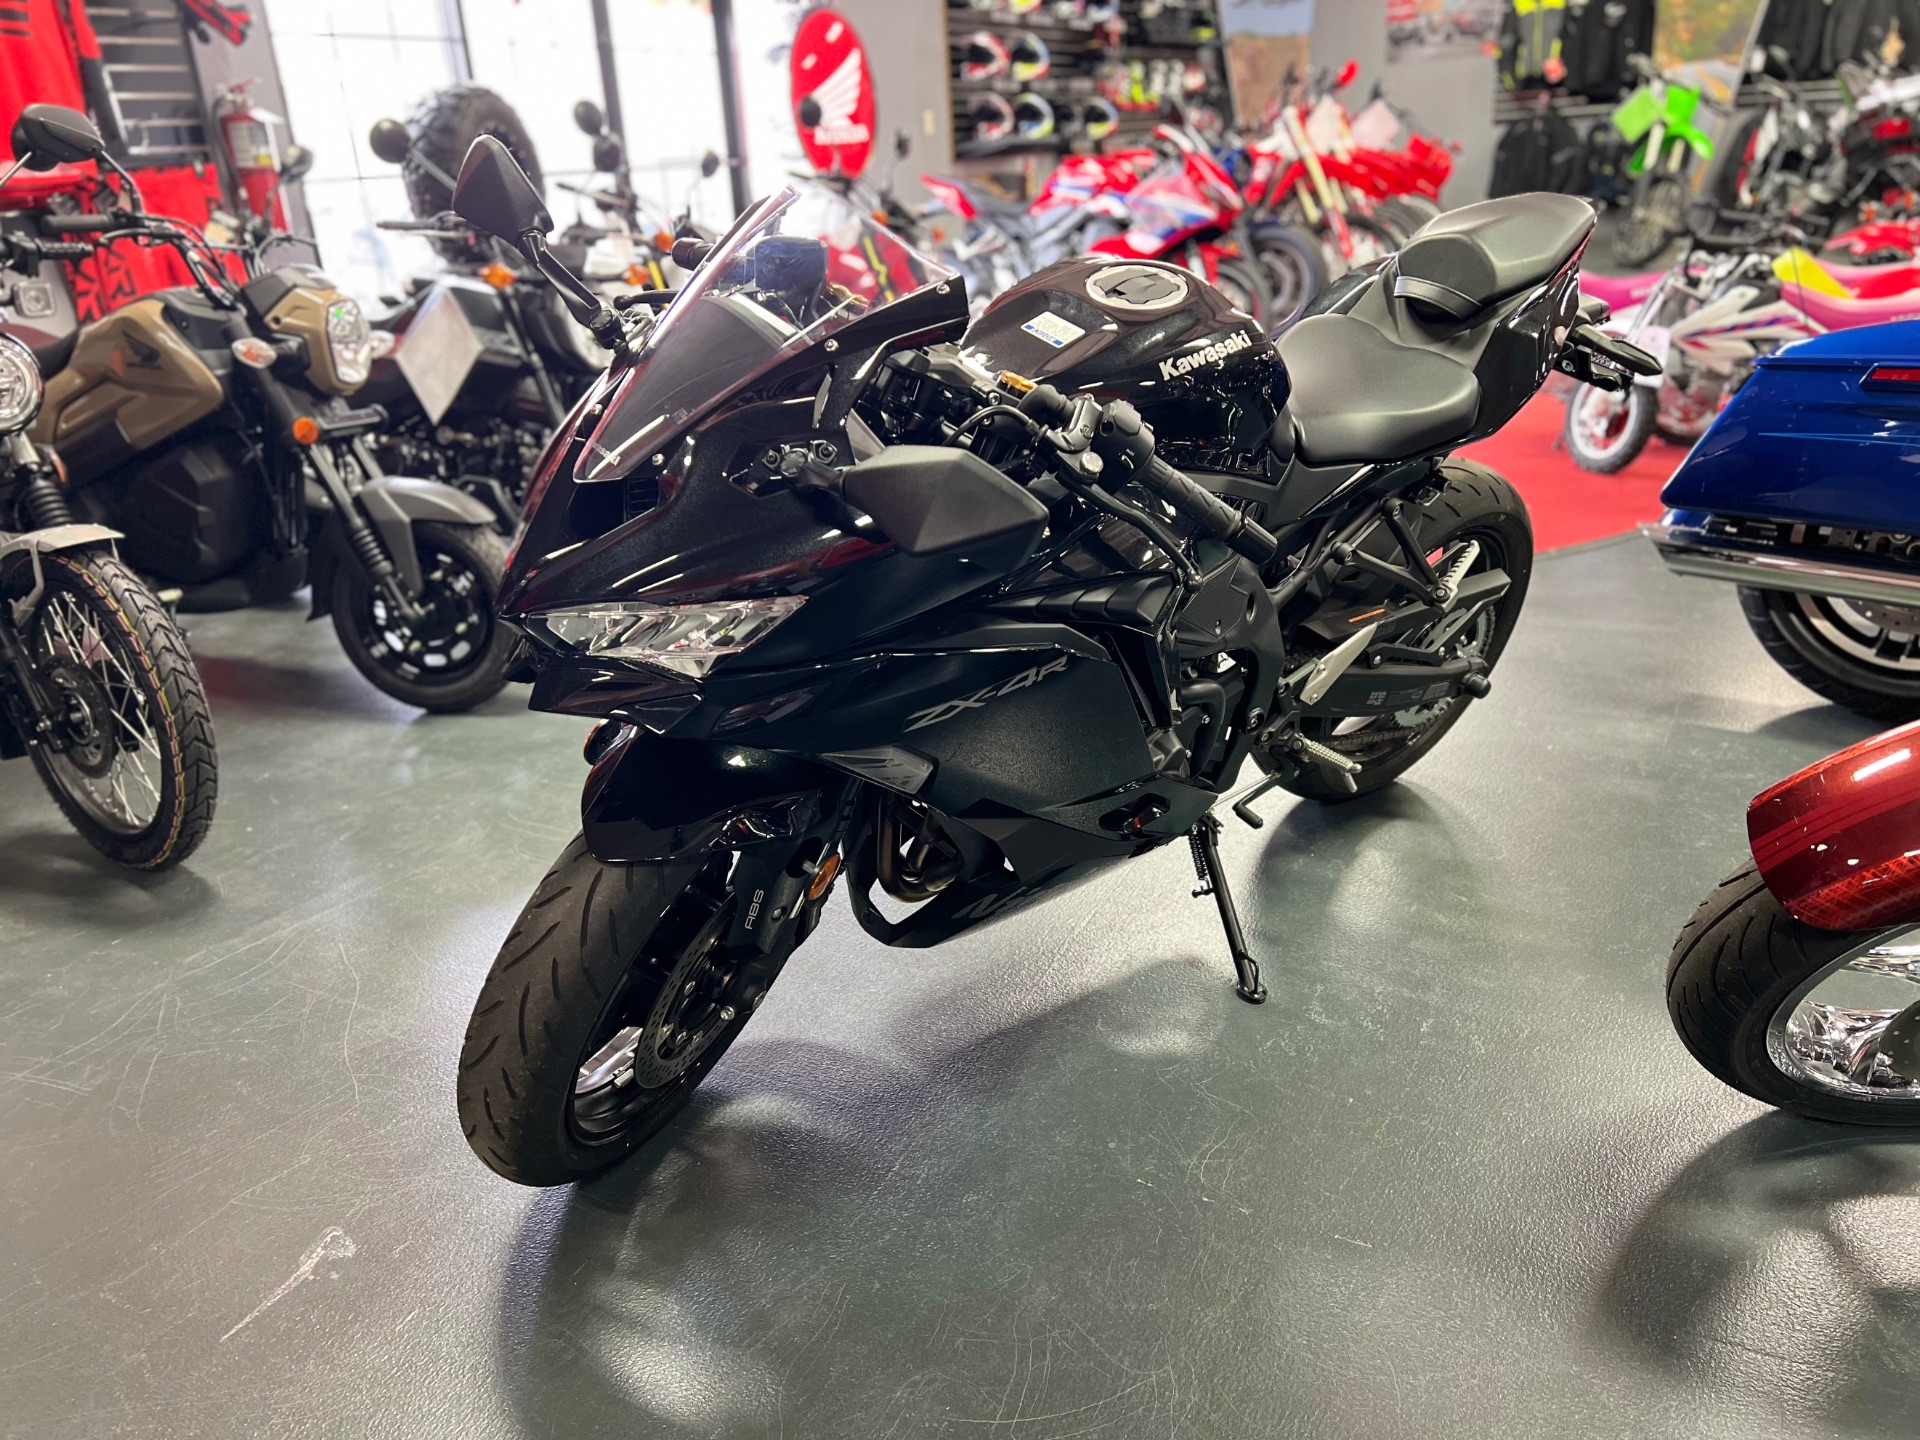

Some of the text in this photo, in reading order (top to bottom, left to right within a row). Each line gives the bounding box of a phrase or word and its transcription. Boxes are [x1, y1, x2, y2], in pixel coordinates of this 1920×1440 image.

[1158, 330, 1253, 381] Kawasaki
[903, 654, 1069, 733] ZX-4R
[745, 889, 764, 930] ABS
